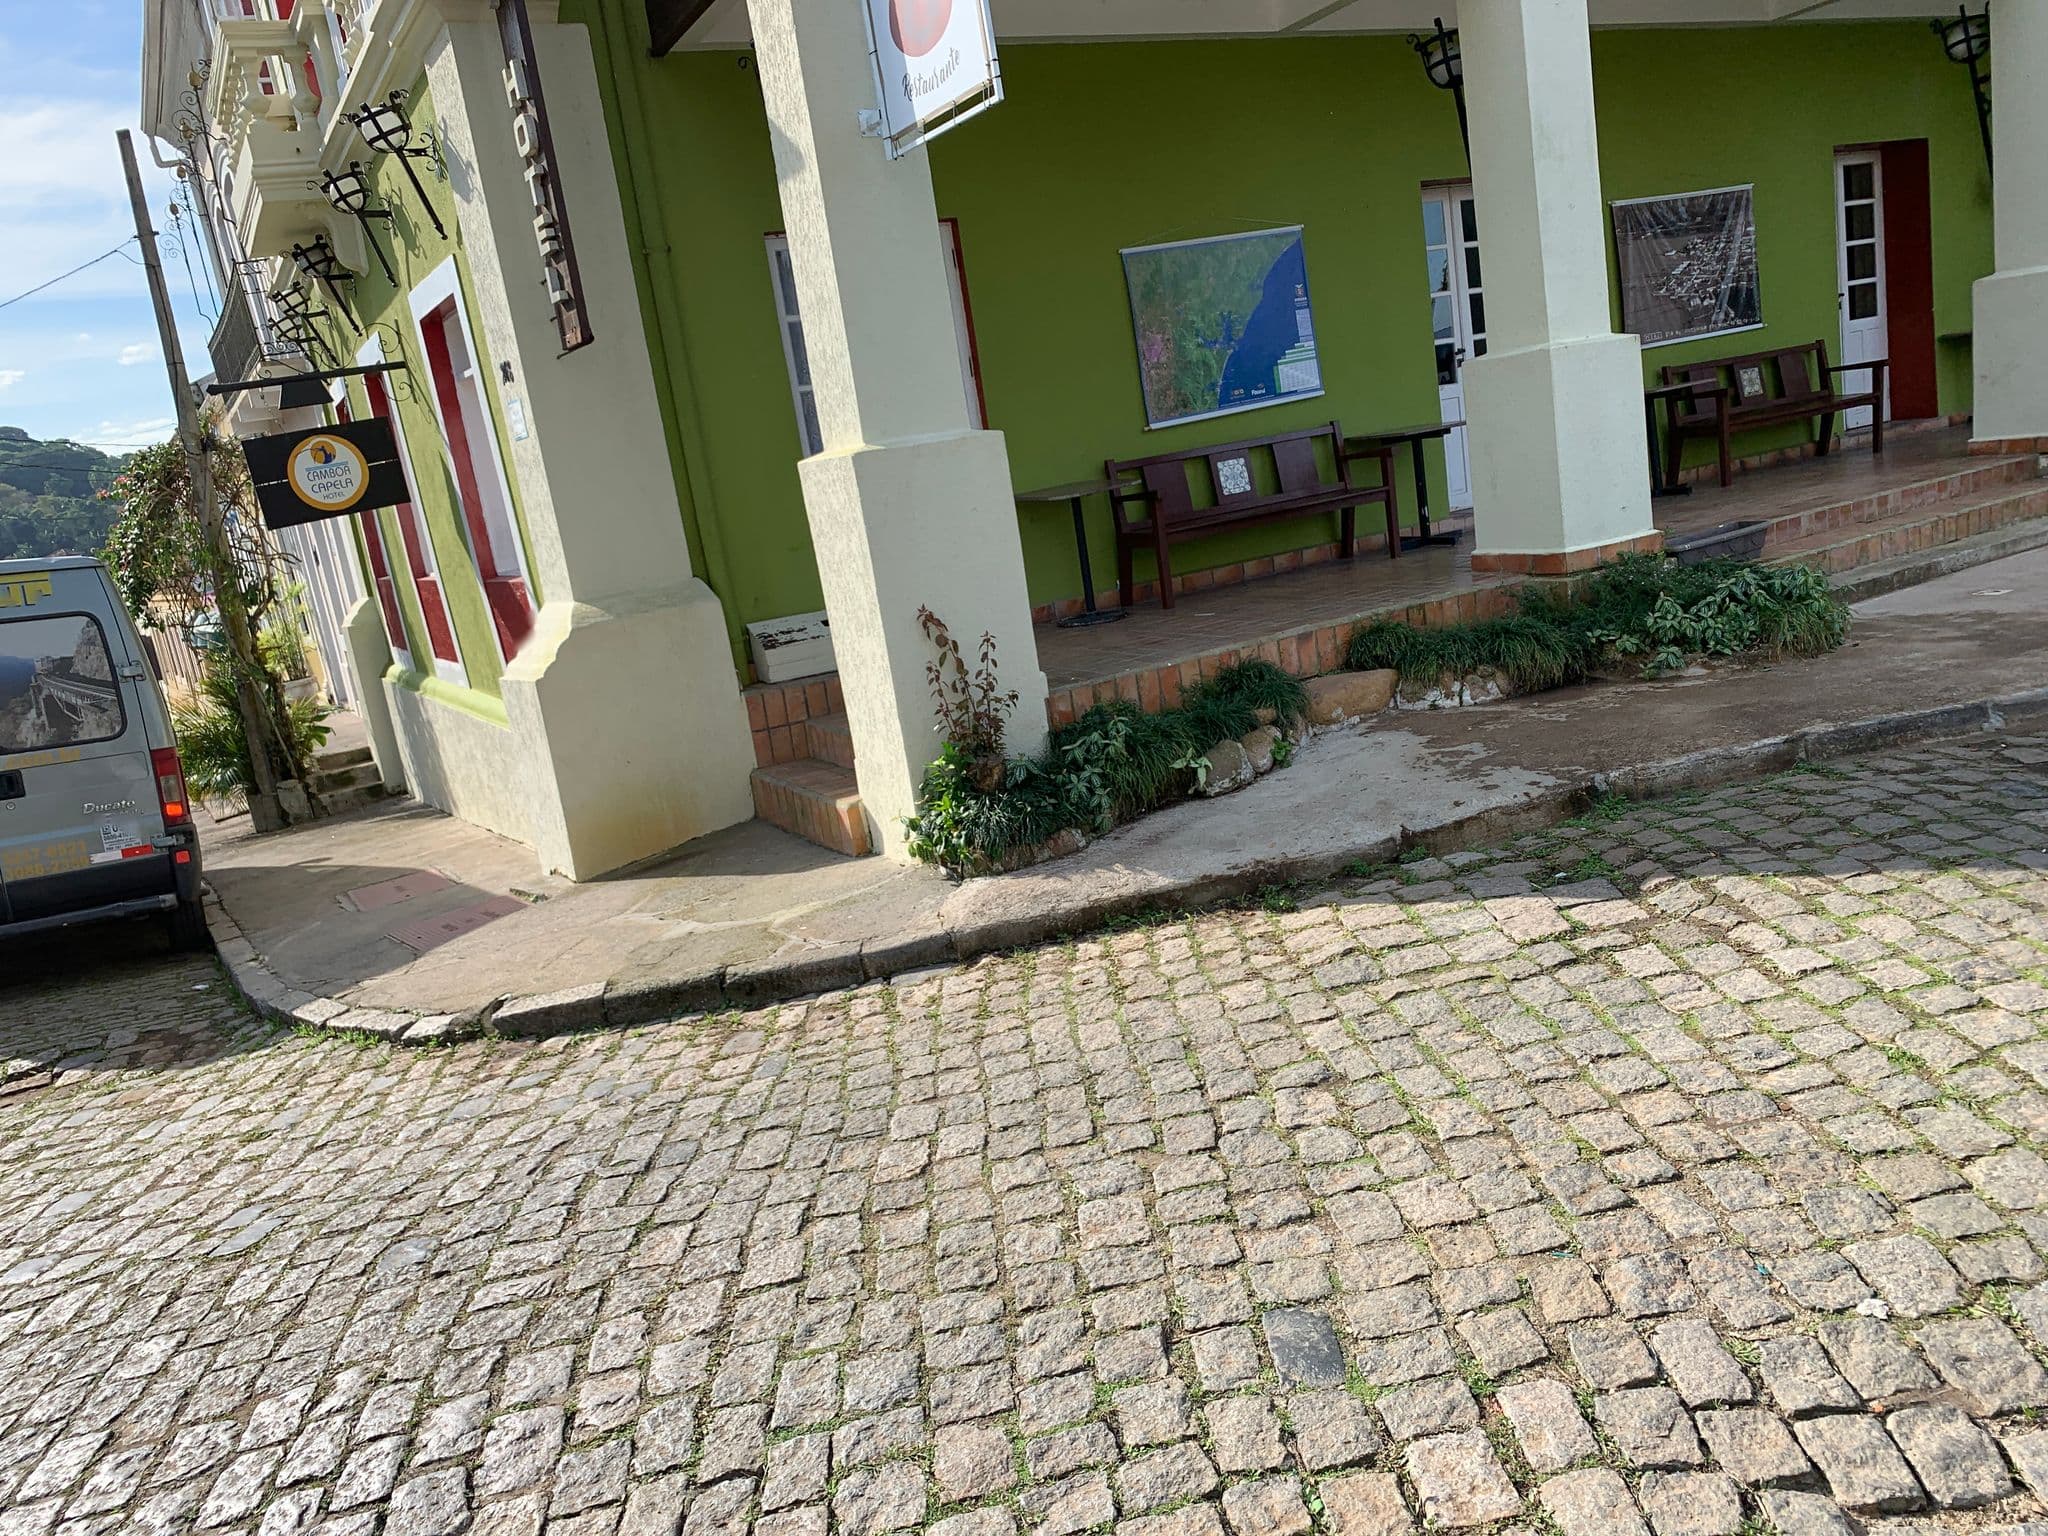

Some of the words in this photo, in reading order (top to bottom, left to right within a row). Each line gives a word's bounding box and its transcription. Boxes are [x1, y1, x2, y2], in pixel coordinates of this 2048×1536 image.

[902, 46, 960, 102] Restaurante
[502, 59, 575, 307] HOTEL
[306, 465, 352, 482] CAMBOA
[311, 477, 354, 494] CAPELA
[322, 491, 346, 500] HOTEL
[83, 800, 136, 814] Ducato
